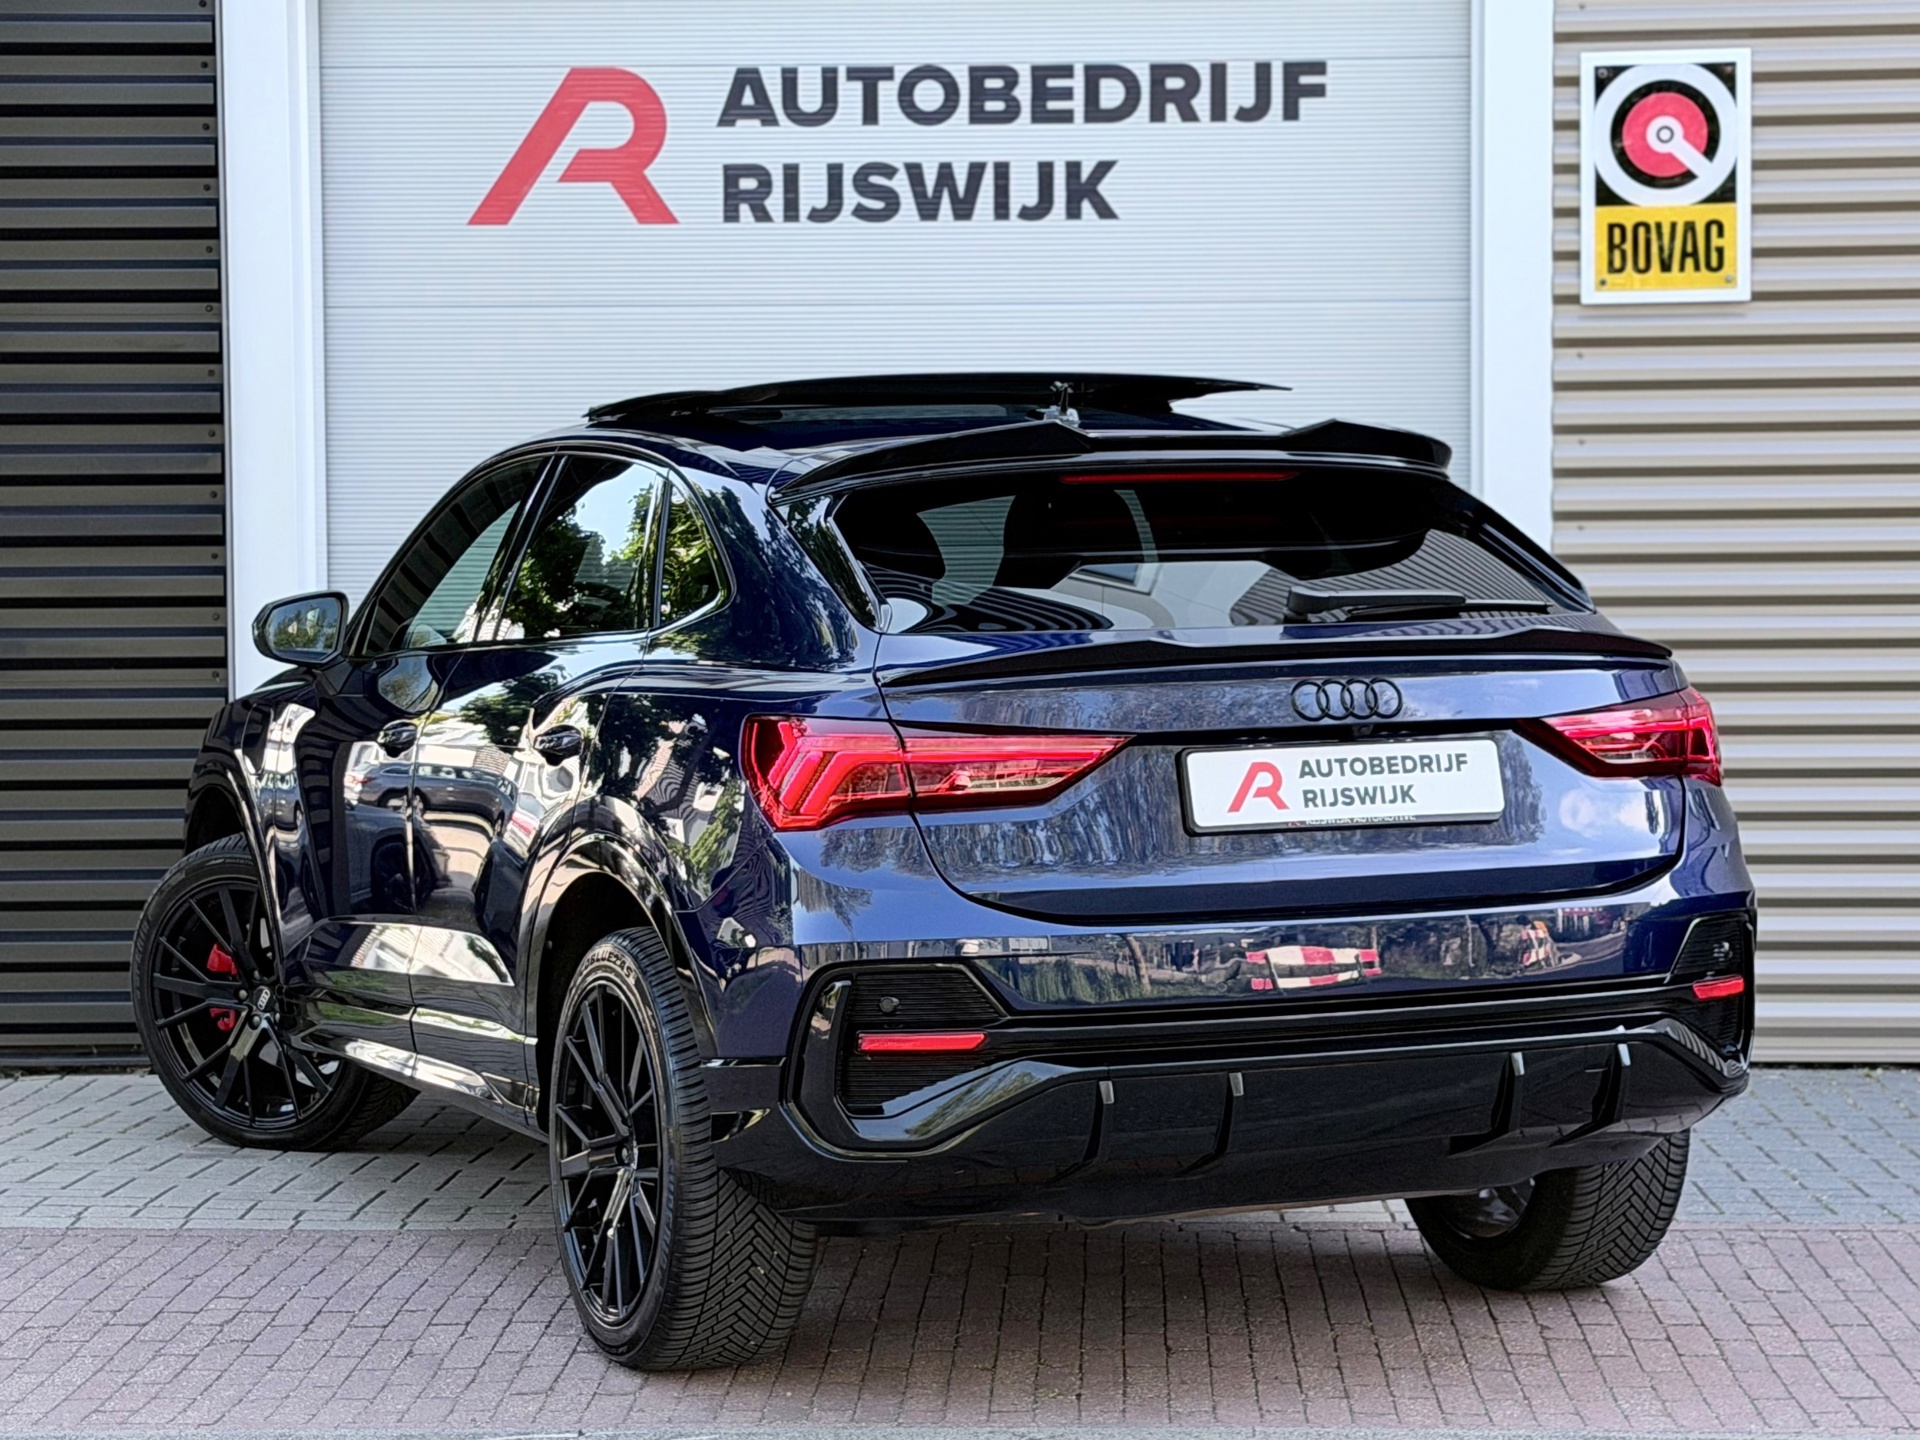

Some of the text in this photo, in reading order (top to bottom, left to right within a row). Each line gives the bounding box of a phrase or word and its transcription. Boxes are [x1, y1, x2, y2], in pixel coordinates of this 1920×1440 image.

[717, 60, 1327, 127] AUTOBEDRIJF
[722, 160, 1119, 223] RIJSWIJK
[1606, 218, 1725, 275] BOVAG
[1299, 752, 1468, 779] AUTOBEDRIJF
[1303, 784, 1417, 808] RIJSWIJK
